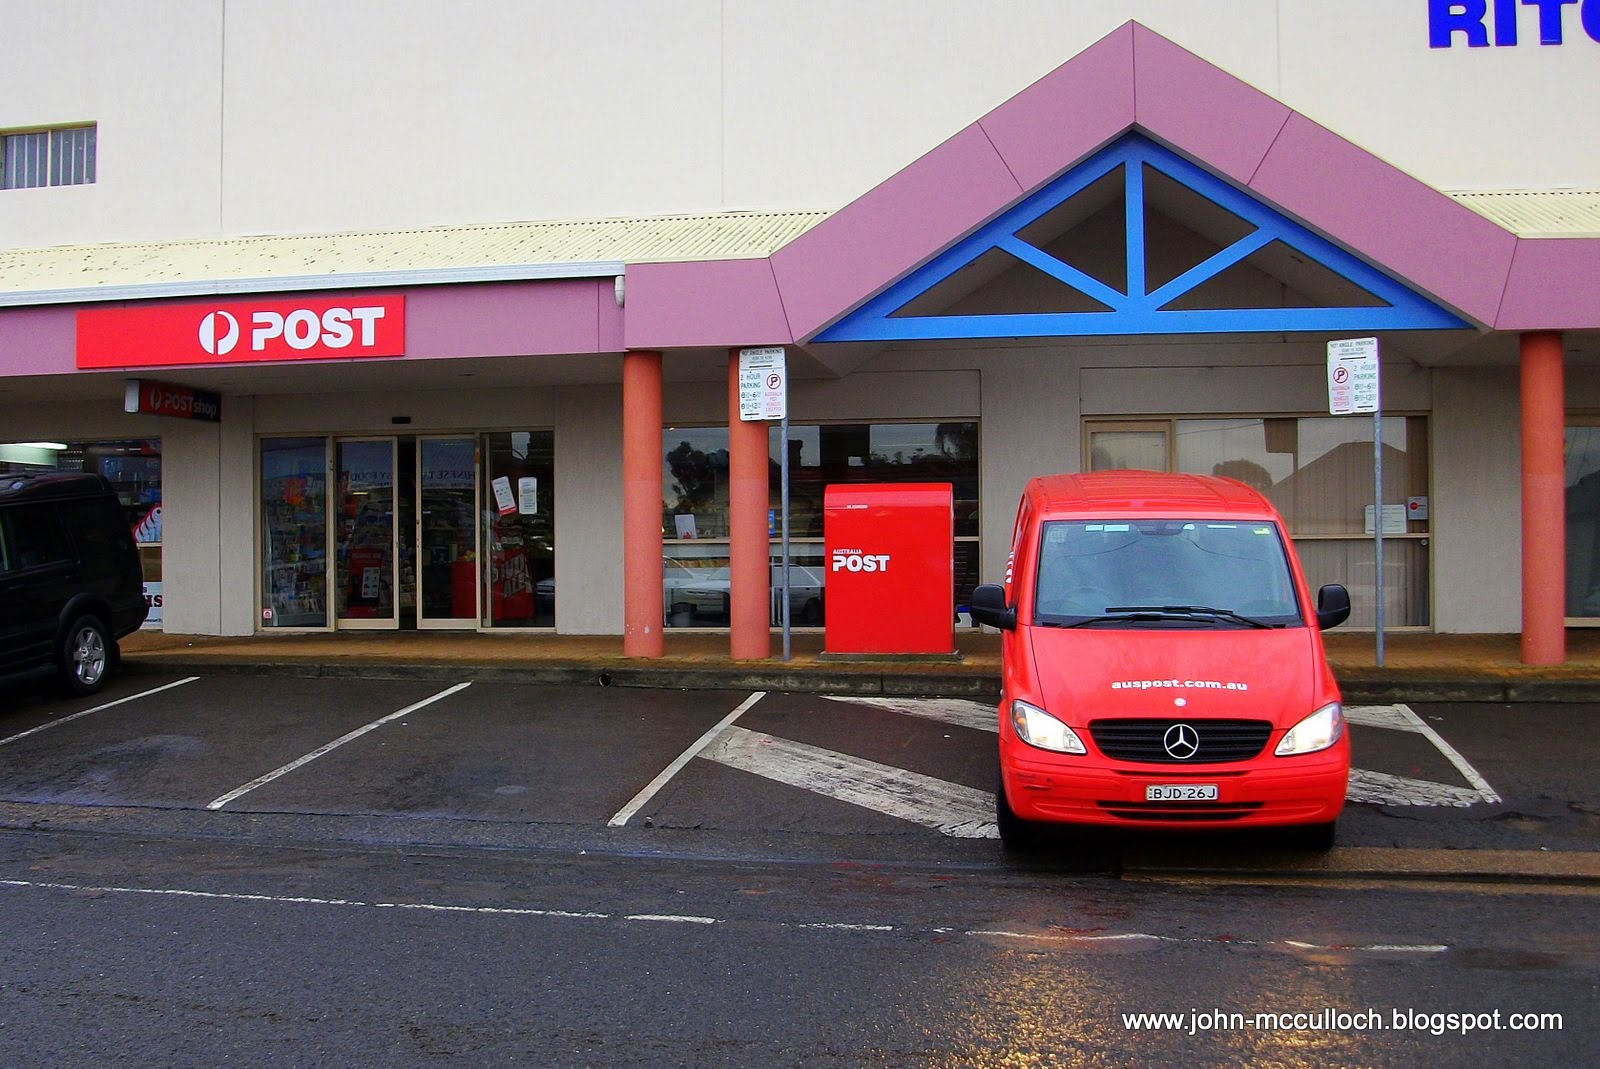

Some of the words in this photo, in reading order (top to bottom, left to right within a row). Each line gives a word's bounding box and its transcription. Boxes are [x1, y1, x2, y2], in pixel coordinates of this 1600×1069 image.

[252, 306, 385, 351] POST
[832, 555, 890, 572] POST
[1111, 679, 1248, 691] auspost.com.au
